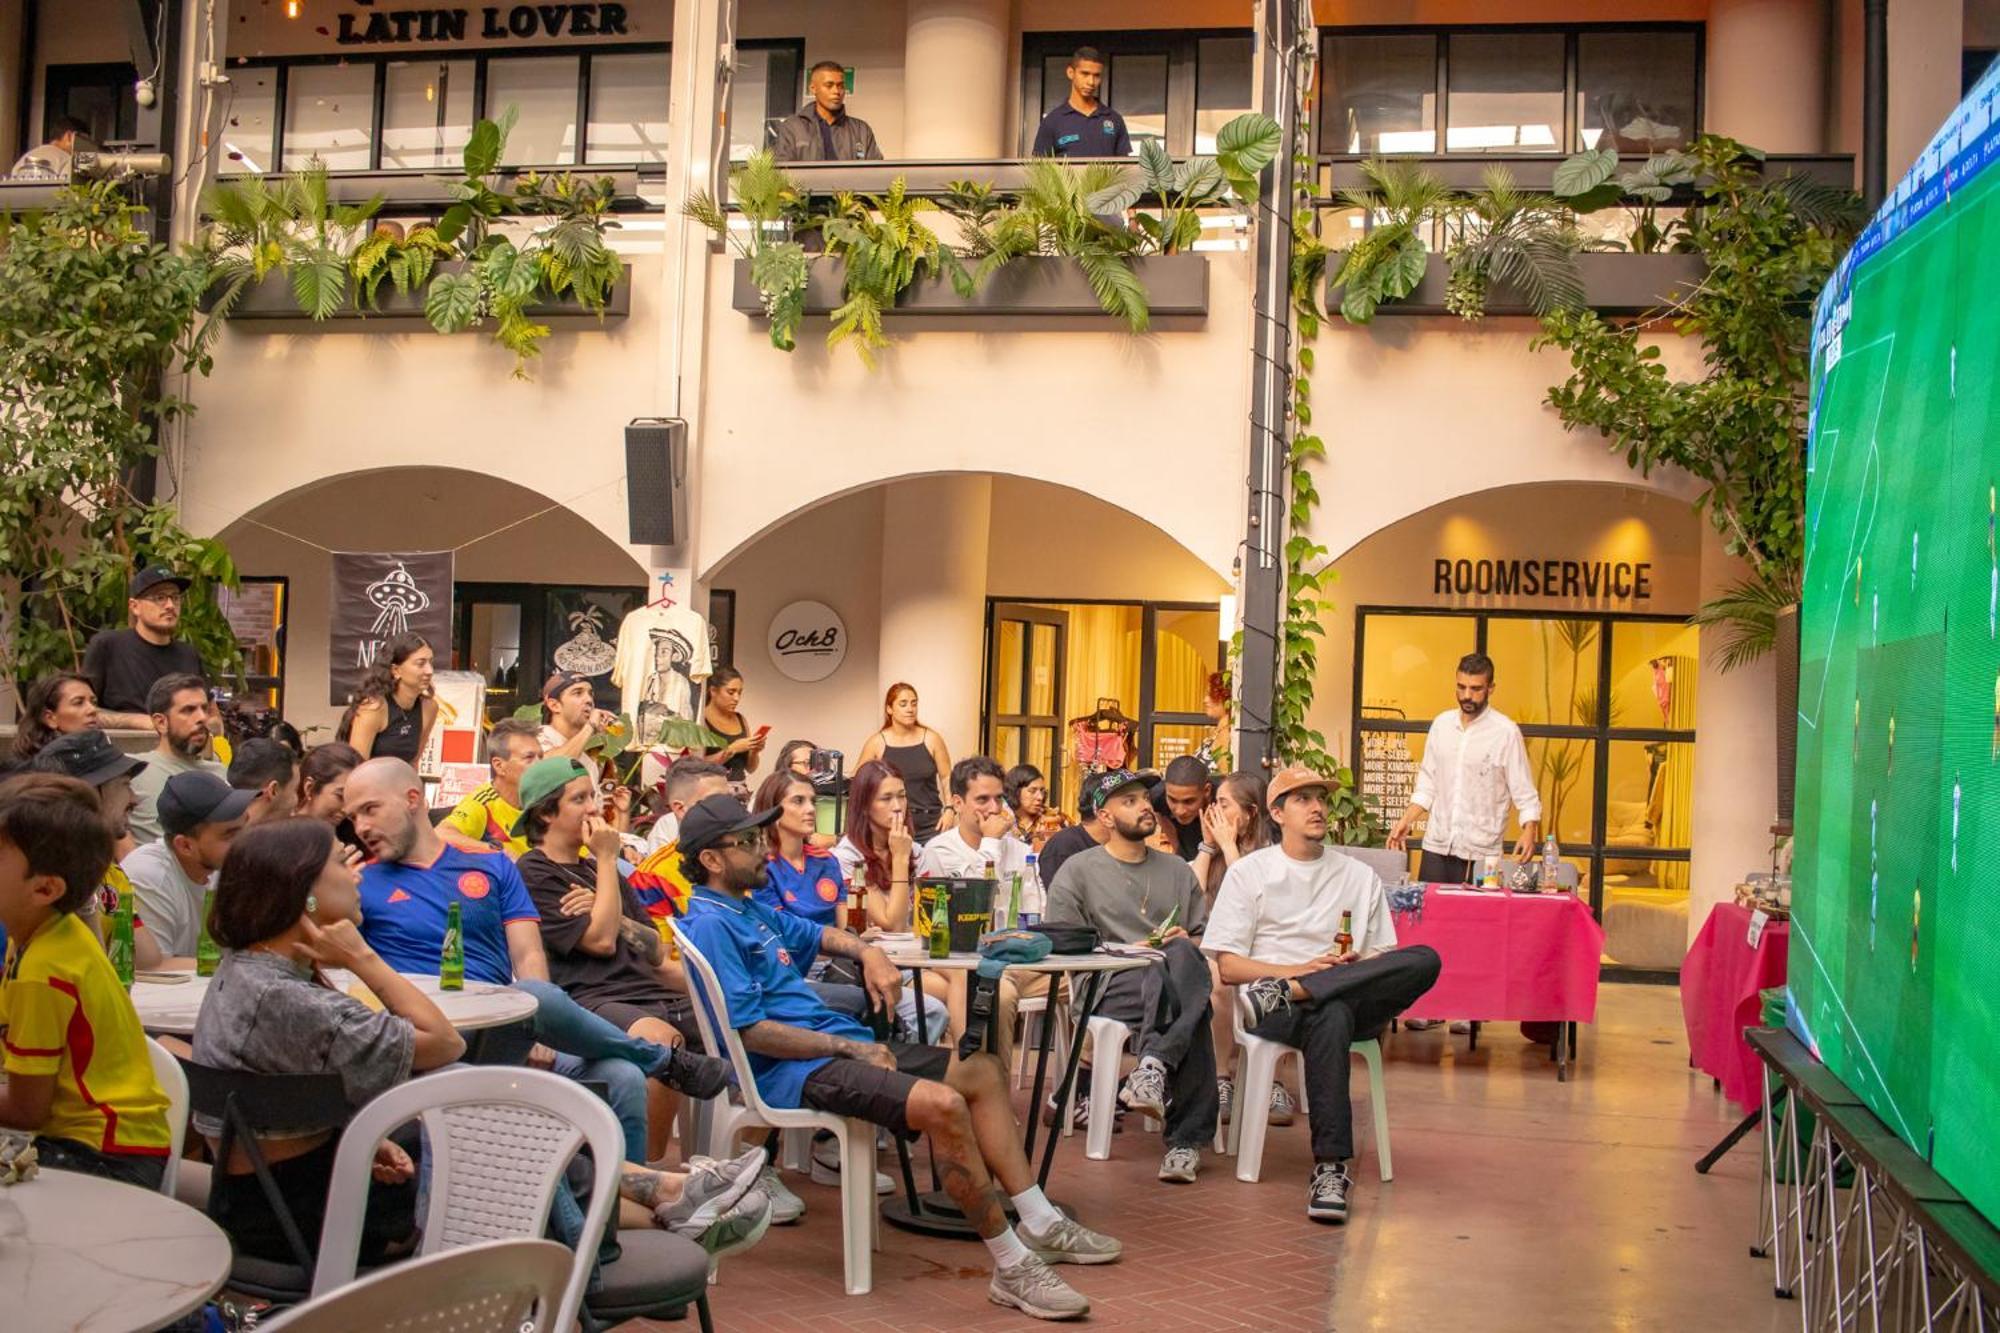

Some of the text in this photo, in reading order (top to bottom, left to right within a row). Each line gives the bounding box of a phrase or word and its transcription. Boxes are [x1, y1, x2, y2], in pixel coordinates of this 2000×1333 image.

[336, 3, 629, 44] LATIN LOVER
[1433, 558, 1652, 600] ROOMSERVICE
[1363, 749, 1386, 760] MORE
[1363, 760, 1386, 771] MORE
[1363, 772, 1414, 783] MORE COMFY
[1363, 783, 1386, 794] MORE
